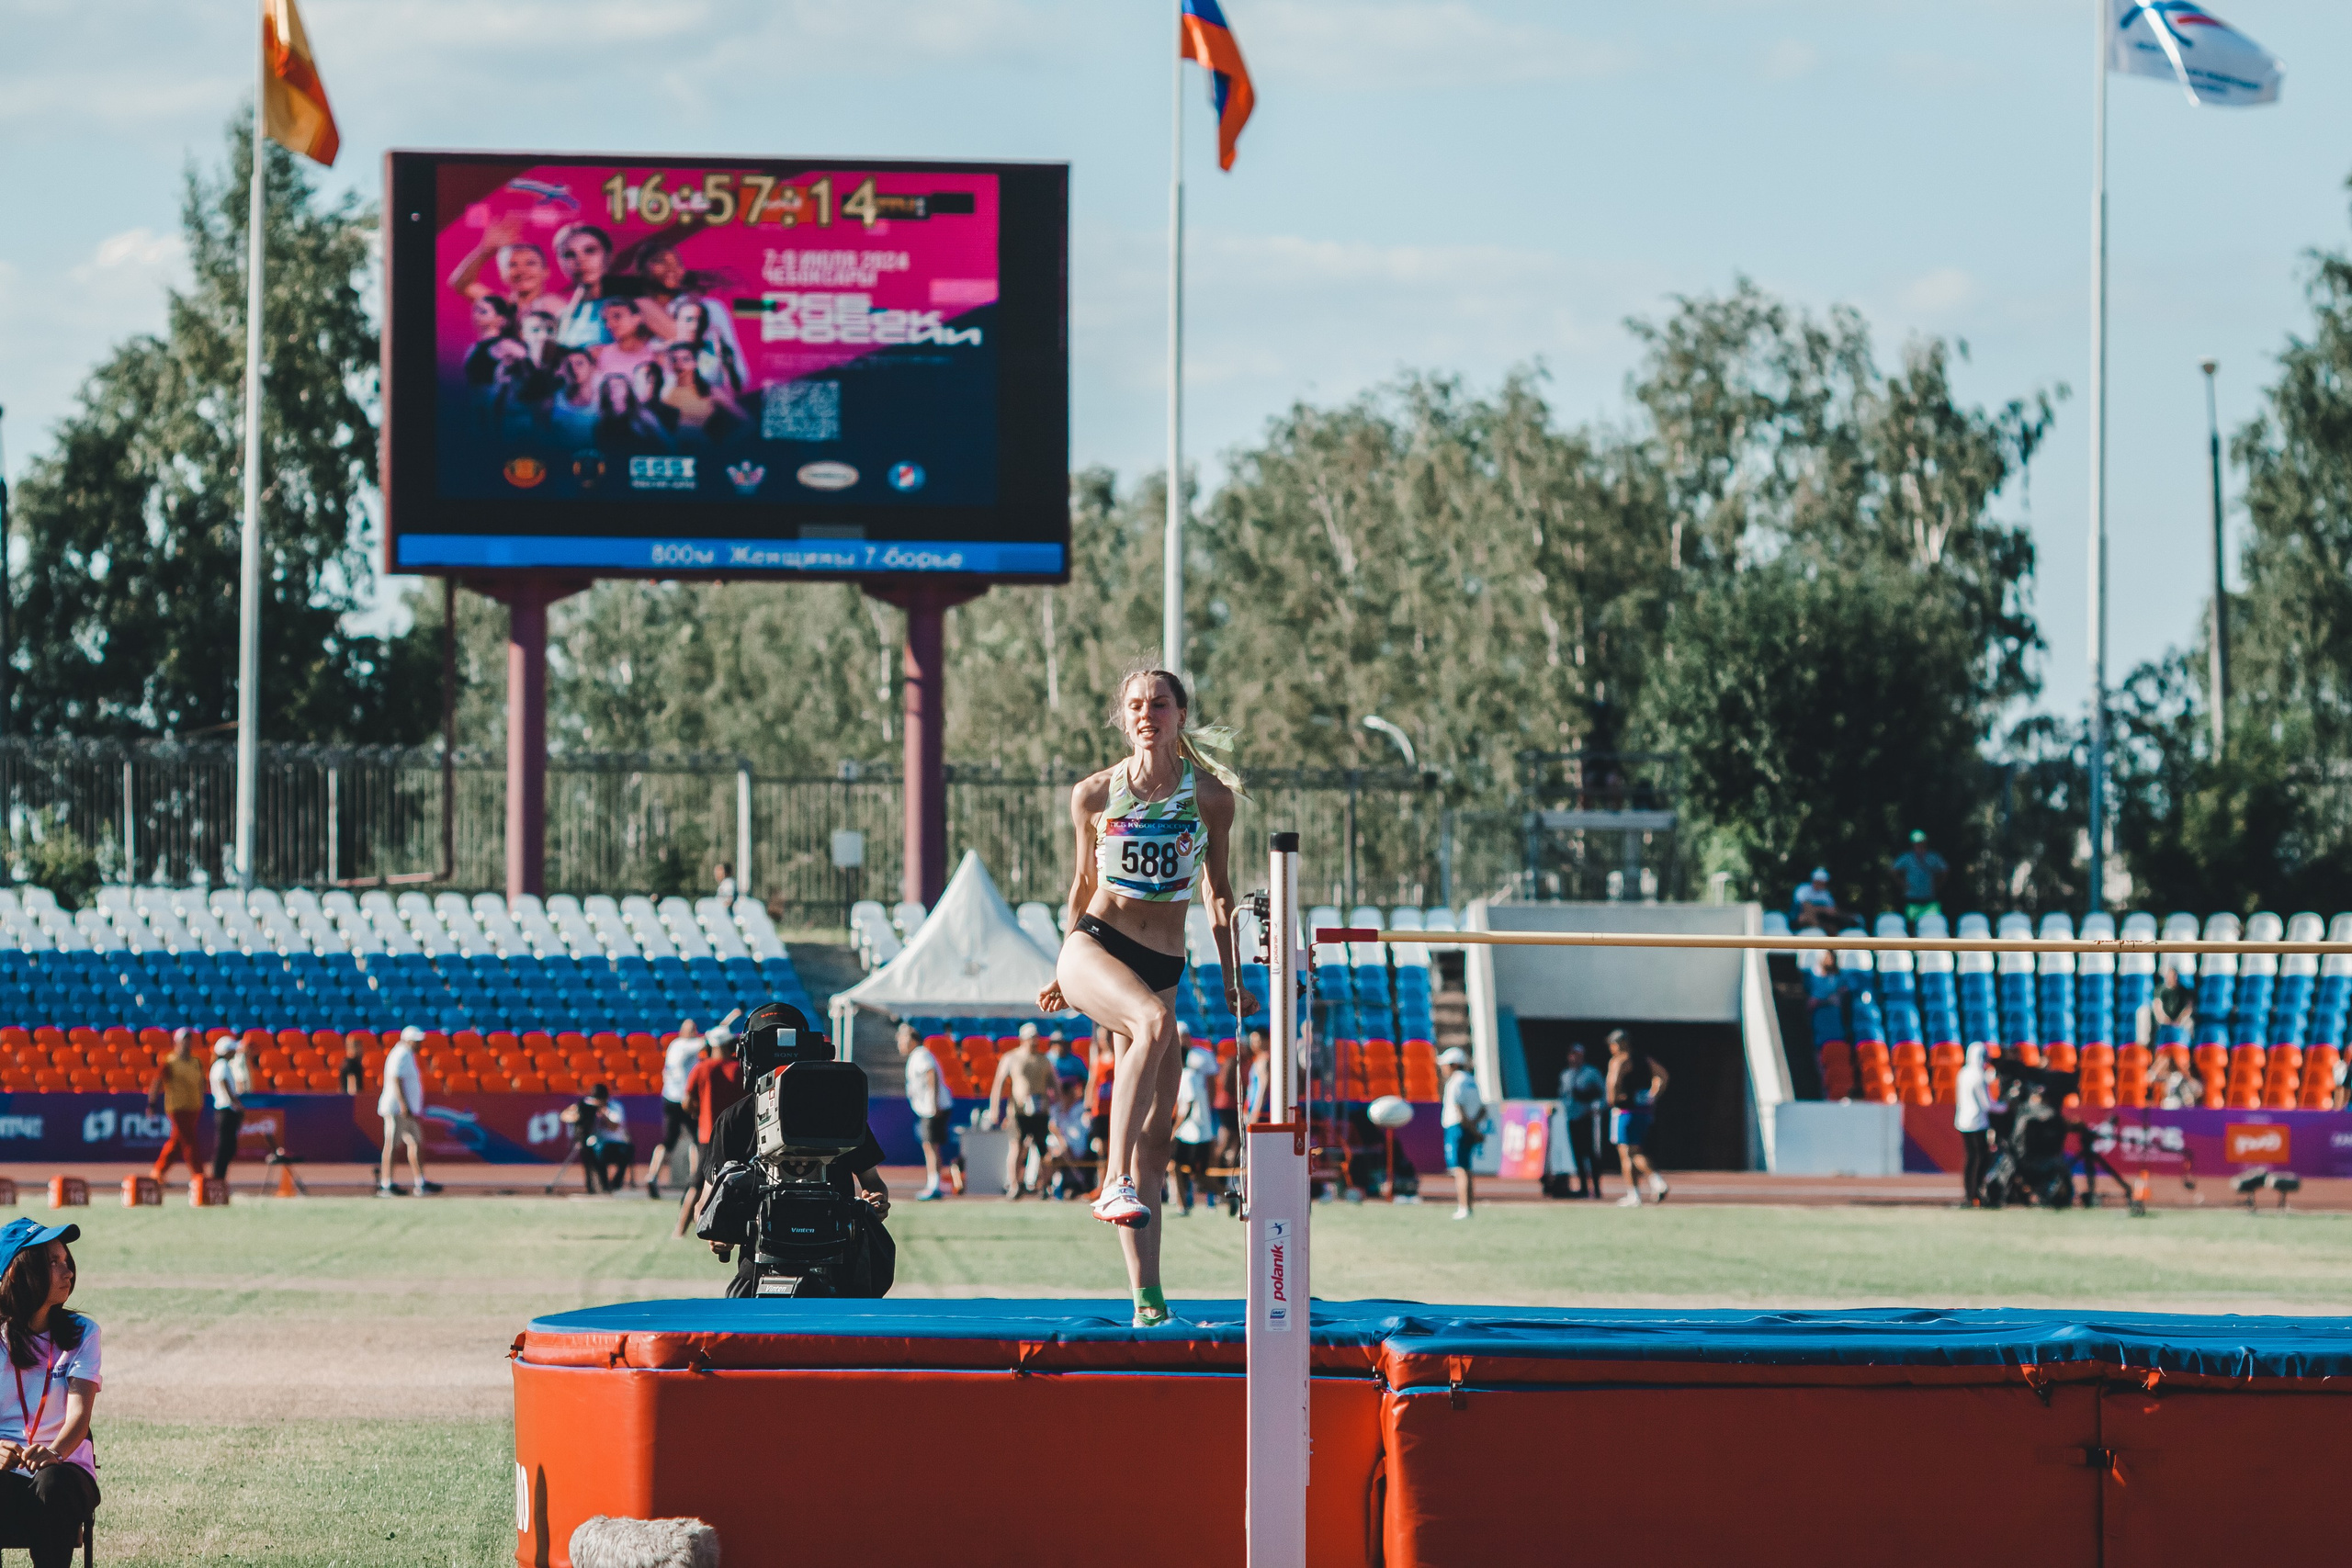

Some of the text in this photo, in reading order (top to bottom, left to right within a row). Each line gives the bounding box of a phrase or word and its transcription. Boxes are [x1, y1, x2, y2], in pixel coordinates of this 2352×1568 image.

[602, 172, 877, 229] 16:57:14
[730, 545, 855, 570] Женщины
[1122, 840, 1179, 878] 588
[1271, 1243, 1286, 1302] polanik
